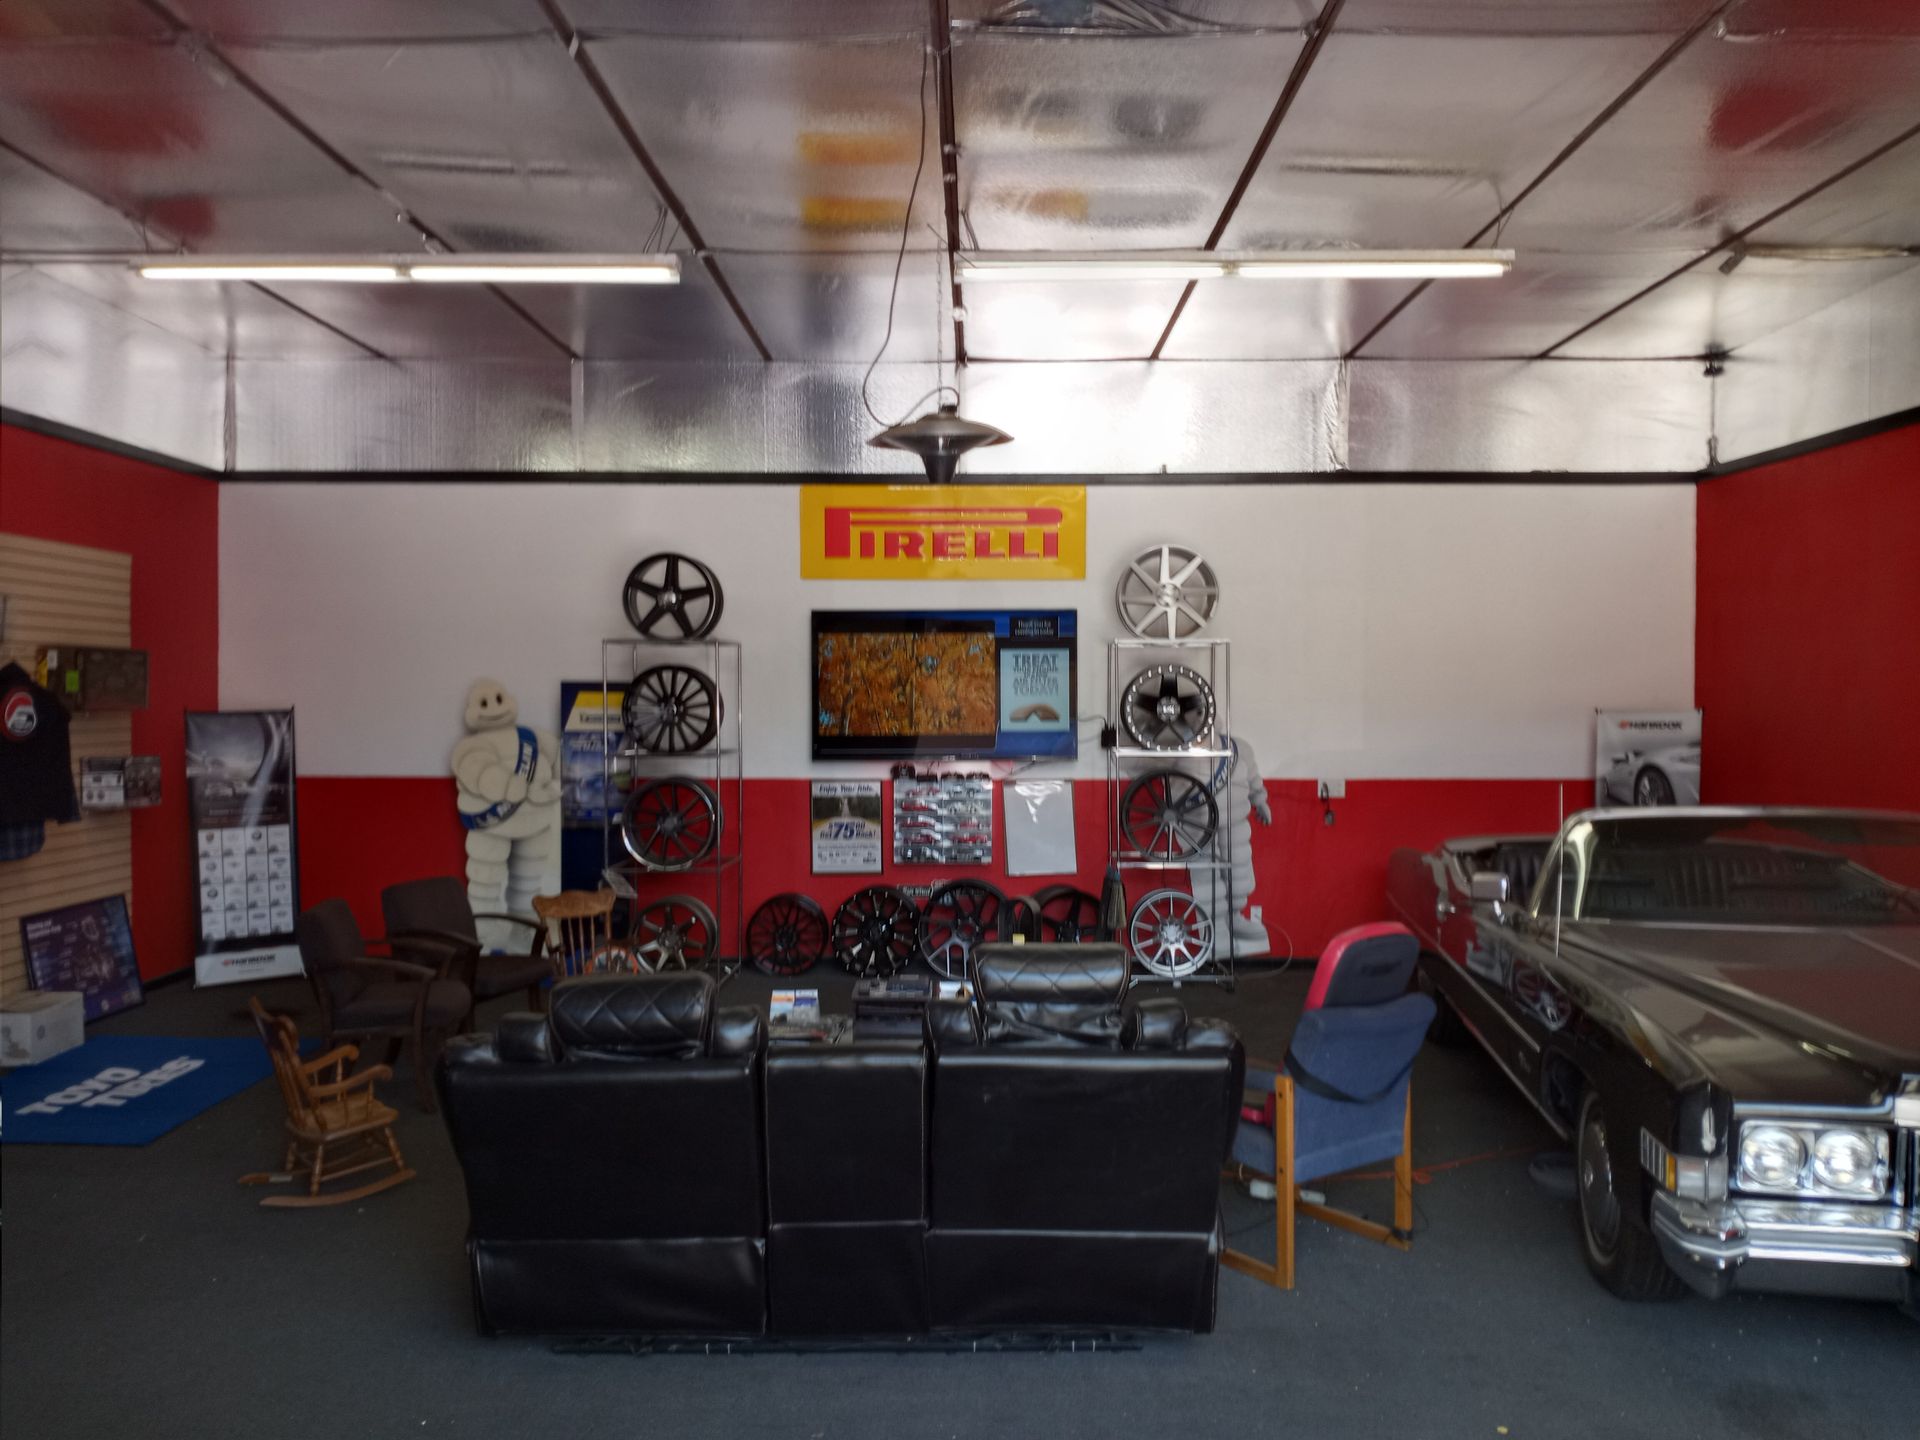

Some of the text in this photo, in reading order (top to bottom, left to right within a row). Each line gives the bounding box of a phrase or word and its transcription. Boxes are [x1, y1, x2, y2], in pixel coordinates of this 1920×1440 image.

[825, 508, 1063, 559] PIRELLI
[1012, 653, 1059, 667] TREAT
[14, 1067, 142, 1114] TOYO
[80, 1055, 206, 1107] TIRES
